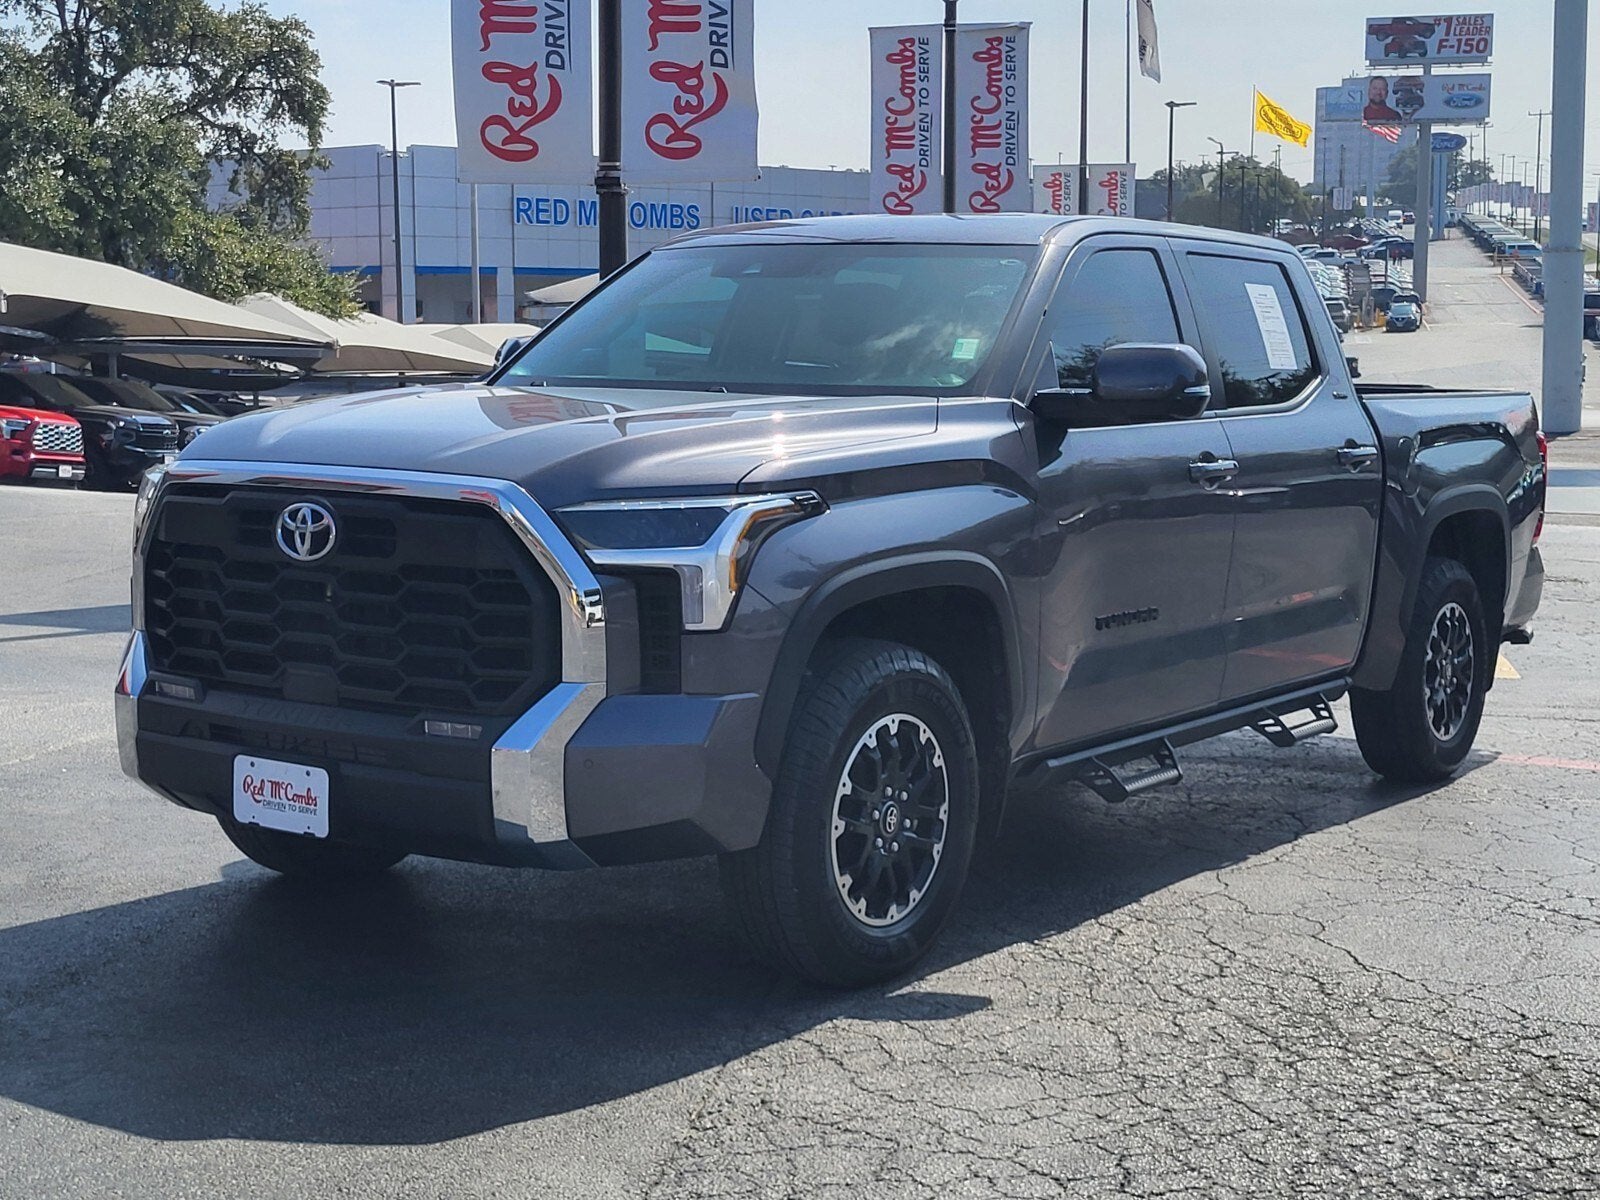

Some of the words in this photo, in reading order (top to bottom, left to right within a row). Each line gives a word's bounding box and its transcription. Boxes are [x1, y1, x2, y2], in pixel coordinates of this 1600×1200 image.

[544, 0, 565, 70] DRIV
[708, 0, 728, 68] DRIV
[1433, 15, 1453, 37] #1
[1455, 15, 1485, 26] SALES
[1436, 38, 1489, 54] F-150
[1453, 26, 1491, 36] LEADER
[918, 37, 930, 83] SERVE
[1005, 35, 1016, 81] SERVE
[480, 61, 563, 162] Red
[644, 60, 728, 160] Red
[885, 37, 916, 159] McCombs
[918, 87, 930, 107] TO
[970, 36, 1003, 158] McCombs
[1005, 86, 1016, 106] TO
[918, 113, 930, 167] DRIVEN
[1005, 111, 1016, 166] DRIVEN
[883, 163, 927, 215] Red
[968, 162, 1014, 213] Red
[1063, 171, 1071, 202] SERVE
[1119, 171, 1127, 200] SERVE
[515, 197, 570, 226] RED
[243, 774, 265, 803] Red
[267, 779, 318, 807] McCombs
[262, 799, 286, 811] DRIVEN
[288, 804, 297, 812] TO
[298, 806, 318, 816] SERVE
